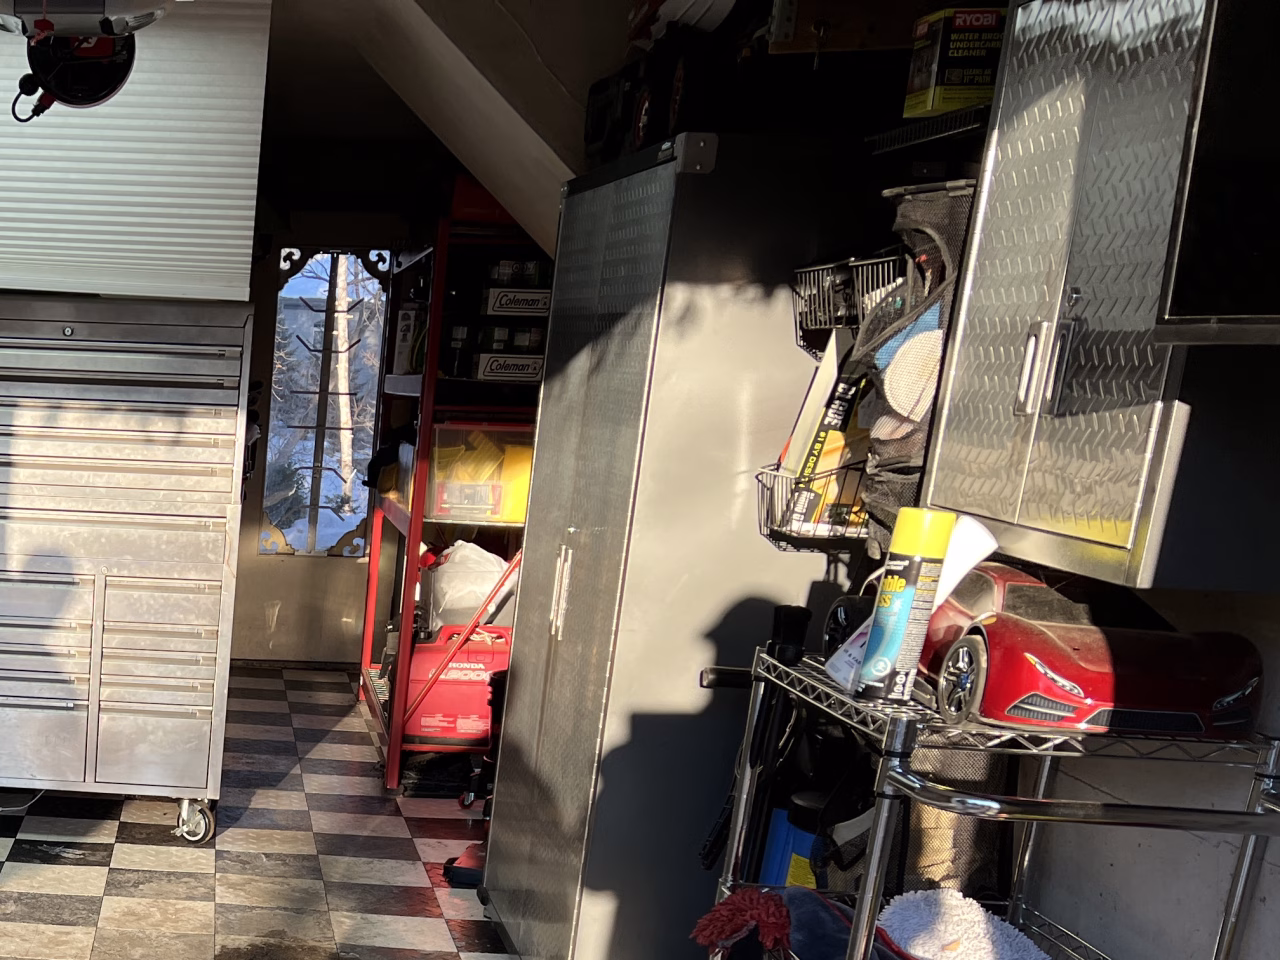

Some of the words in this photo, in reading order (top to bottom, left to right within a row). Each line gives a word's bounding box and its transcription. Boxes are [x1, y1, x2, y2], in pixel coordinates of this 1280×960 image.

[955, 13, 997, 26] RYOBI
[948, 49, 987, 57] CLEANER
[499, 294, 540, 307] Coleman
[489, 359, 530, 372] Coleman
